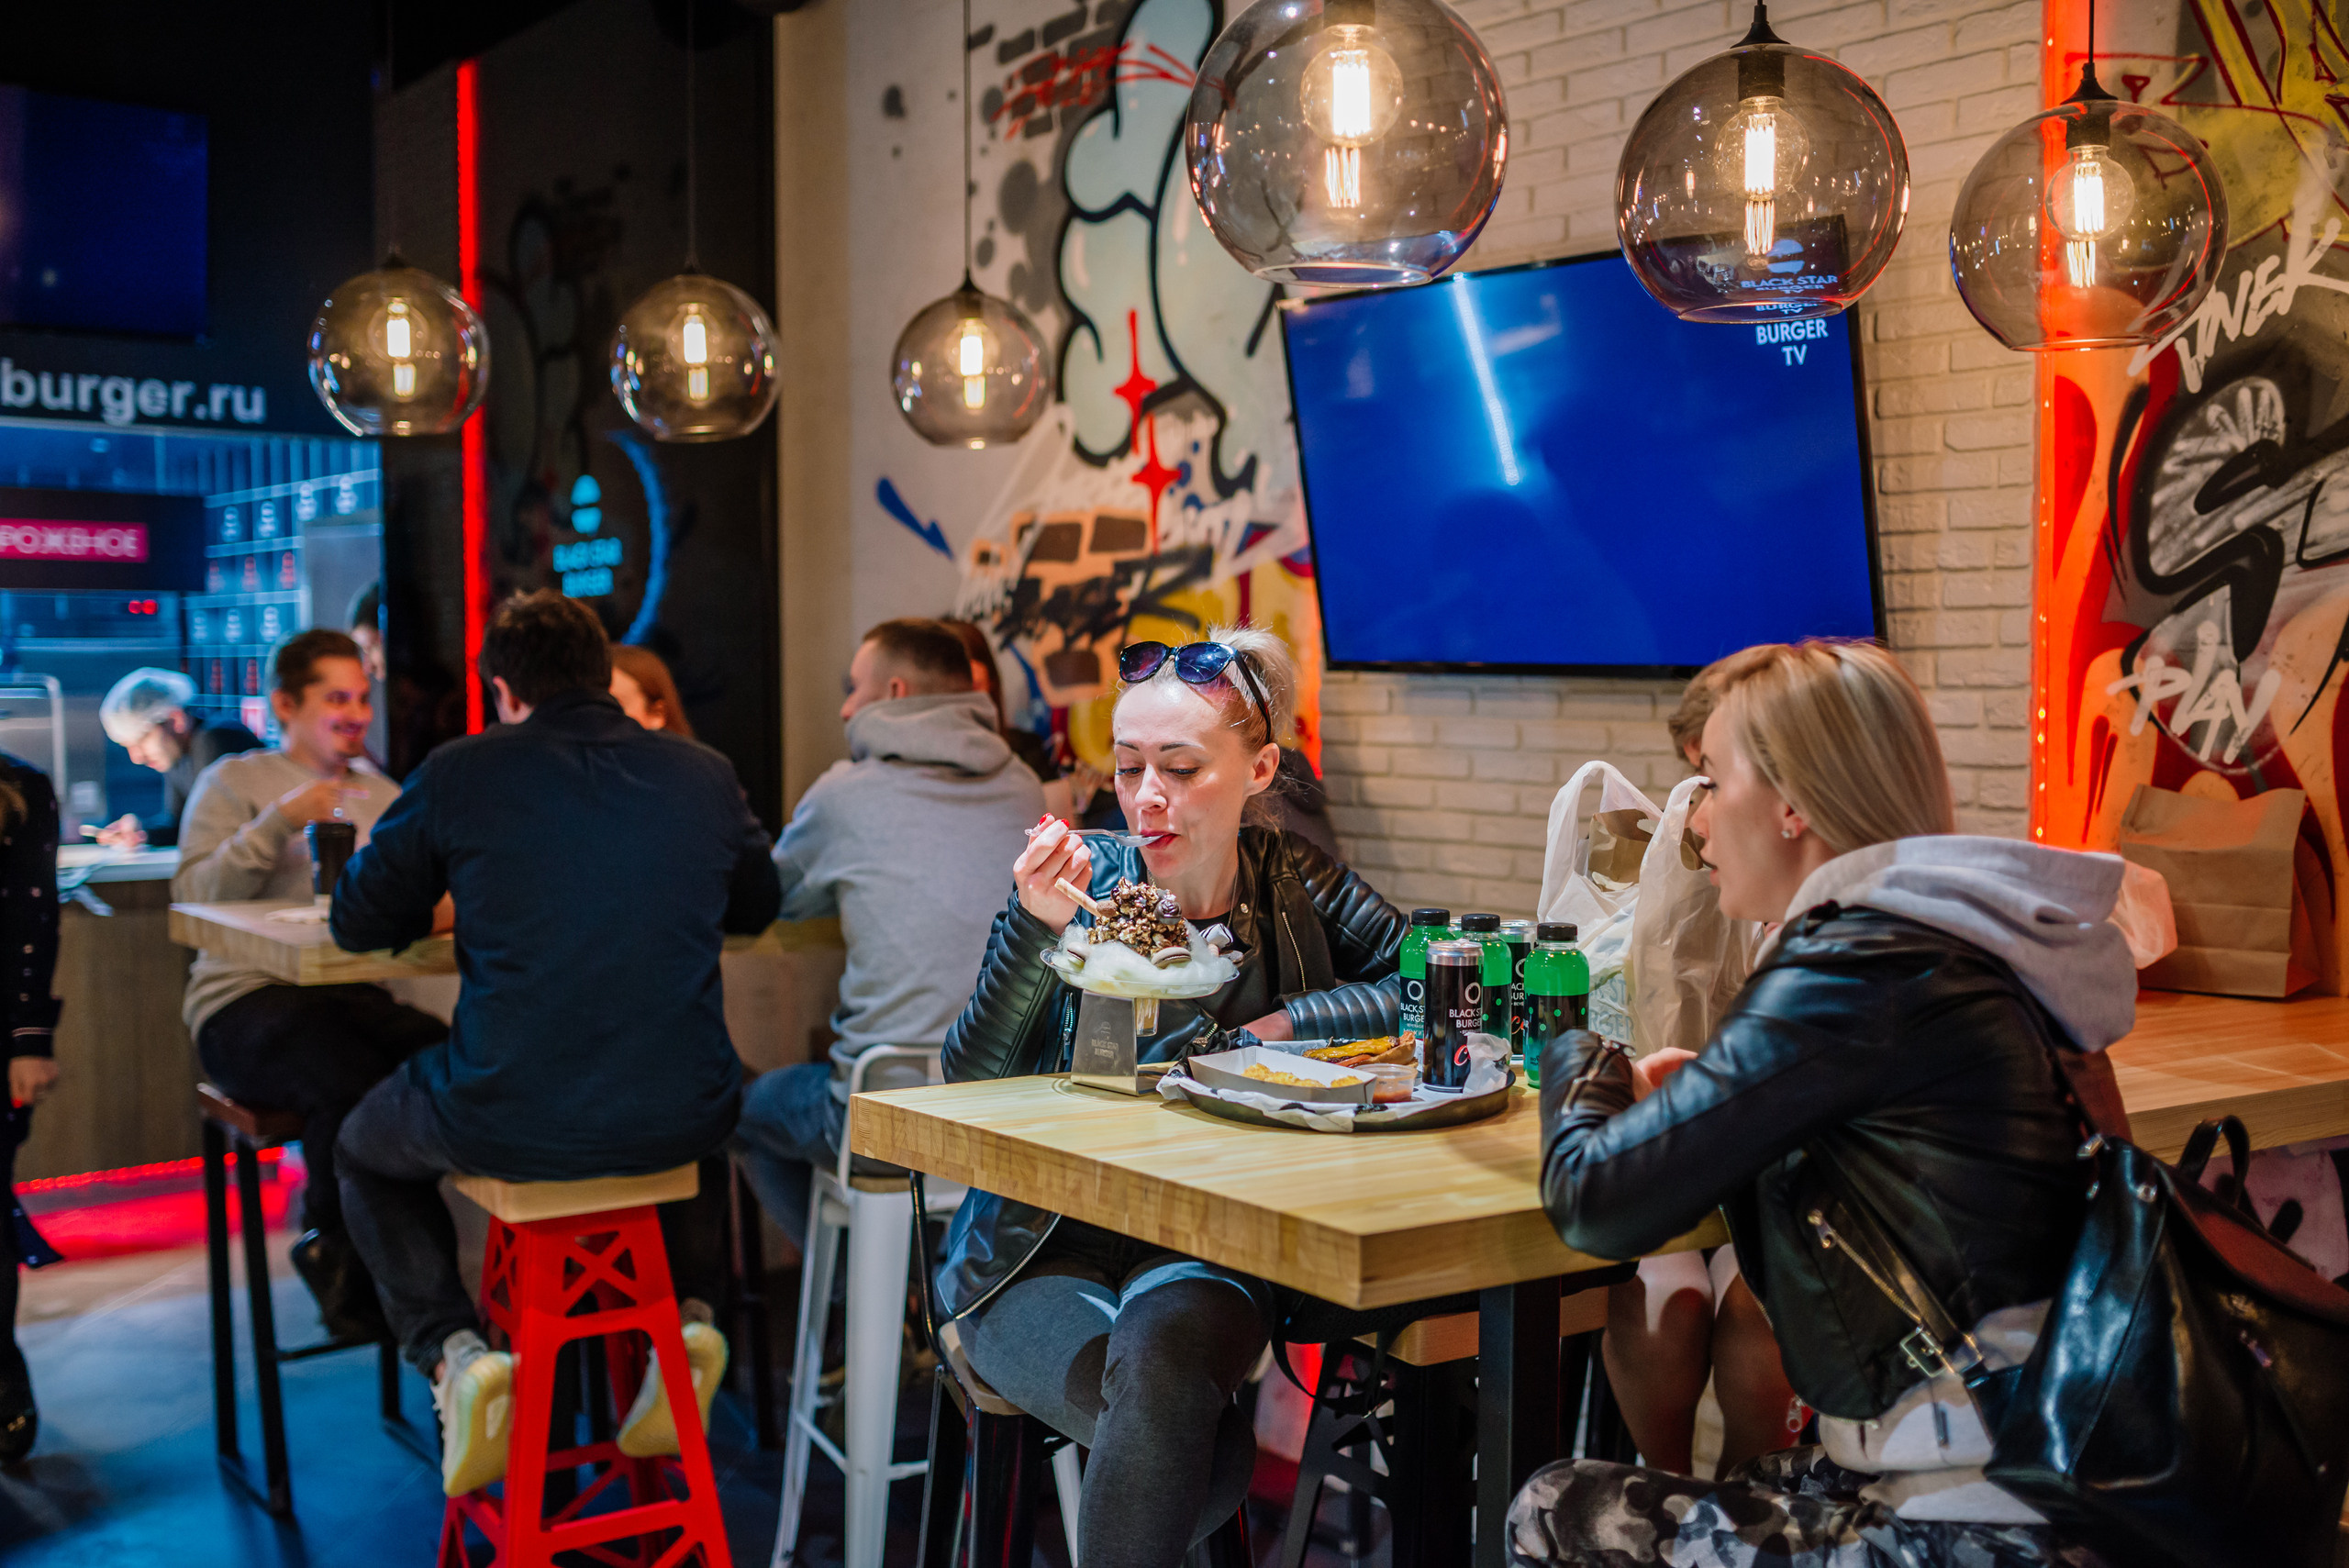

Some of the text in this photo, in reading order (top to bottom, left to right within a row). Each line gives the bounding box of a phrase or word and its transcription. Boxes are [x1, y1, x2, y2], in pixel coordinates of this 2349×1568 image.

[1741, 275, 1838, 288] BLACK STAR
[1755, 318, 1829, 345] BURGER
[1781, 344, 1808, 366] TV
[0, 357, 267, 426] burger.ru
[1400, 1002, 1418, 1013] BLACK
[1449, 1008, 1475, 1018] BLACK
